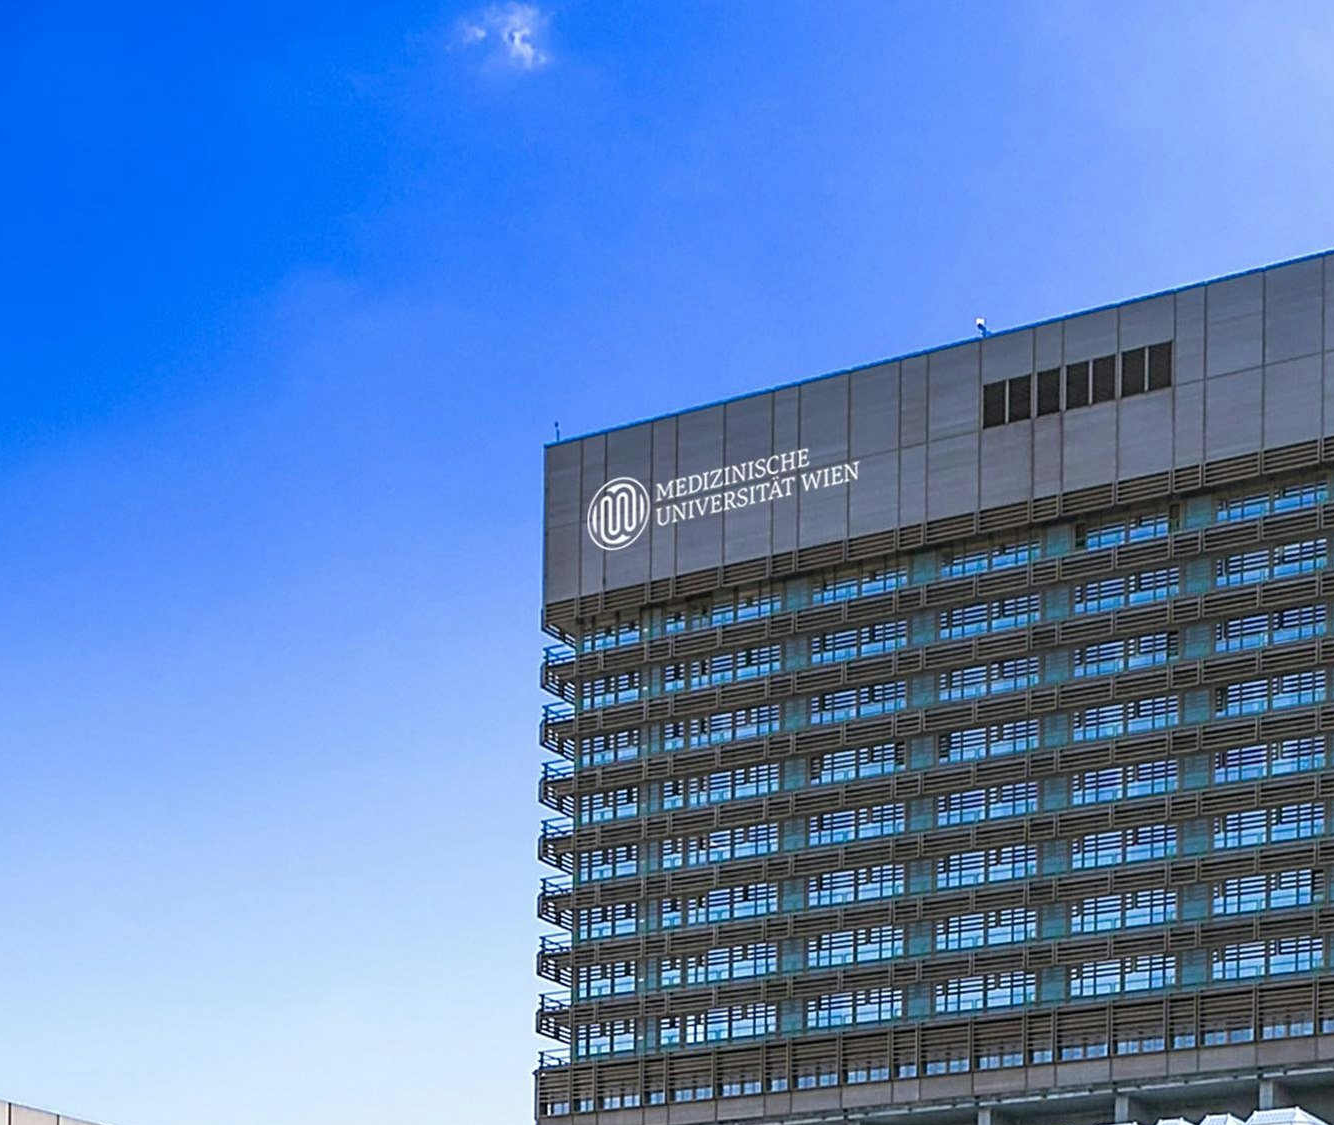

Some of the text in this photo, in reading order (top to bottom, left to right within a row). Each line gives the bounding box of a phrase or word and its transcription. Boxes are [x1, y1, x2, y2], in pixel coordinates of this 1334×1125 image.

[655, 447, 810, 502] MEDIZINISCHE
[655, 460, 860, 527] UNIVERSITÄT WIEN
